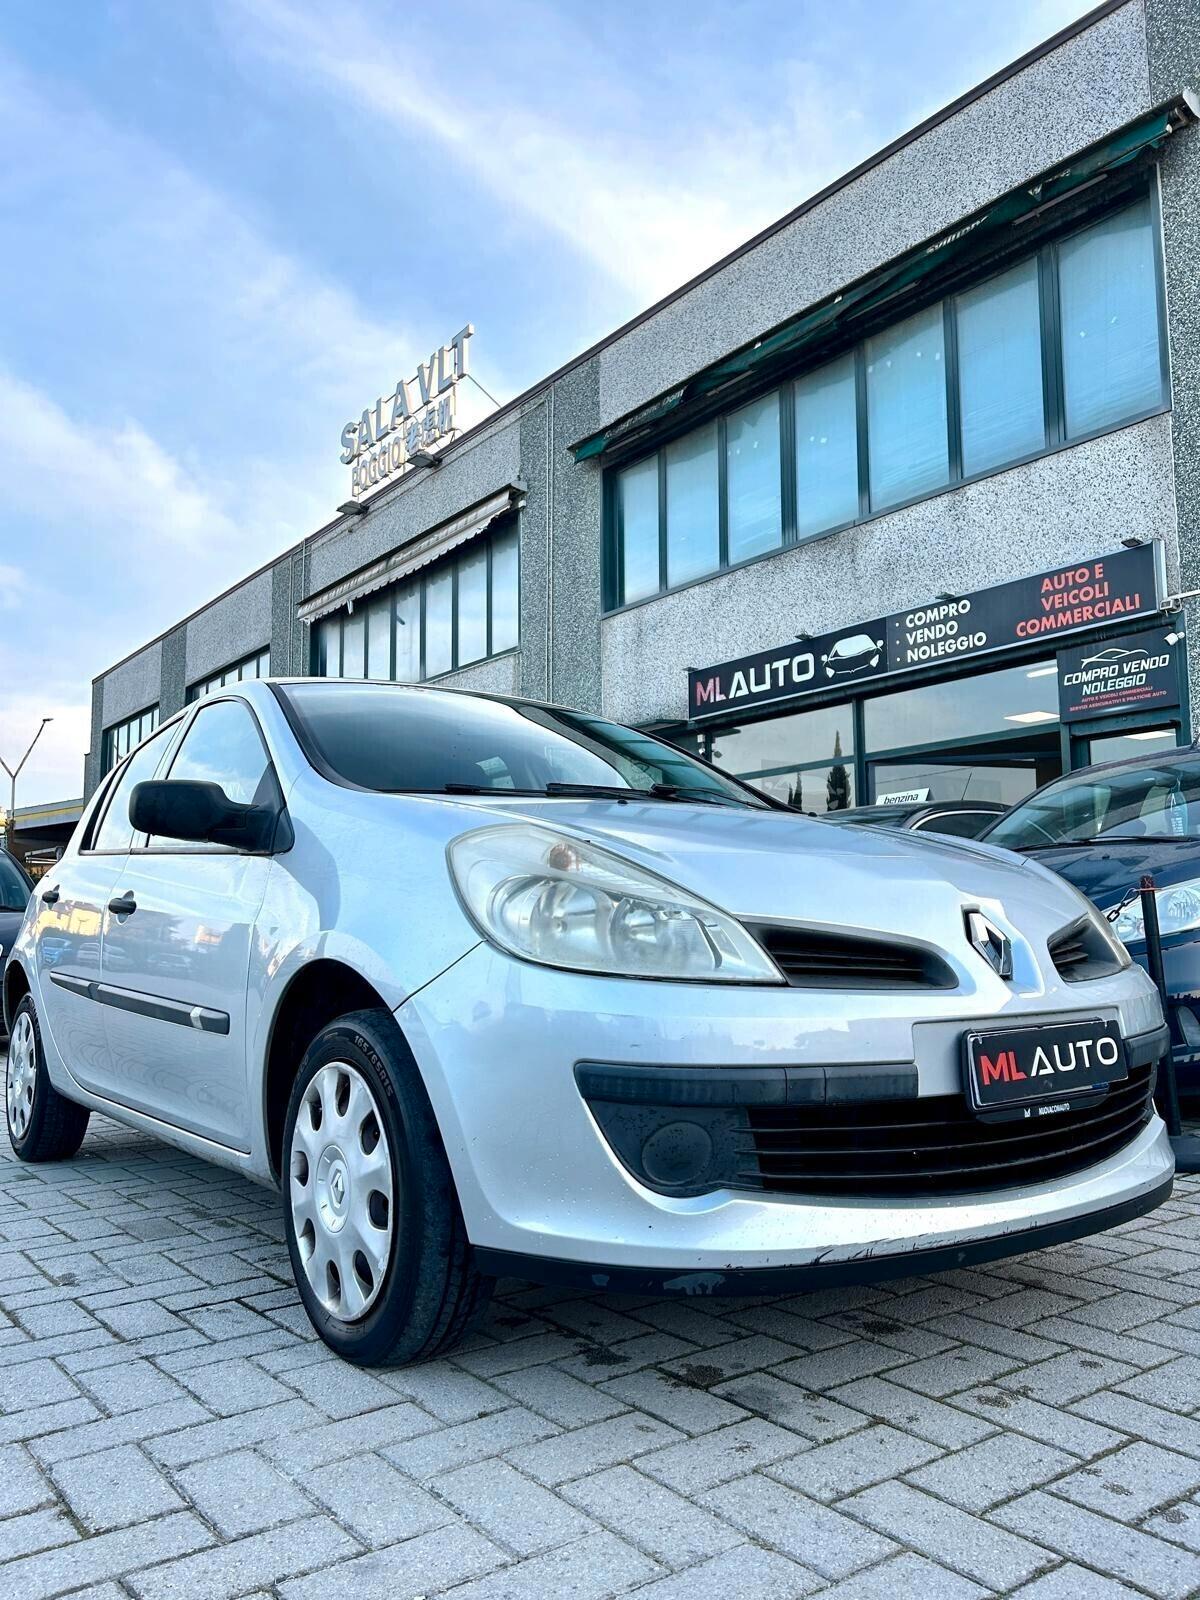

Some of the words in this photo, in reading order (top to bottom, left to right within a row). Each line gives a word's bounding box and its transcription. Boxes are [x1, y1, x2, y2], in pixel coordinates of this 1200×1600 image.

[340, 379, 414, 464] SALA
[417, 324, 475, 405] VLT
[1041, 567, 1090, 593] AUTO
[1094, 563, 1105, 579] E
[1041, 582, 1109, 611] VEICOLI
[905, 599, 971, 628] COMPRO
[1016, 594, 1141, 637] COMMERCIALI
[905, 620, 959, 646] VENDO
[906, 631, 987, 663] NOLEGGIO
[728, 652, 815, 699] AUTO
[1064, 664, 1119, 686] COMPRO
[1122, 654, 1170, 674] VENDO
[1082, 673, 1147, 695] NOLEGGIO
[884, 793, 919, 804] benzina
[980, 1051, 1028, 1085] ML
[1030, 1037, 1119, 1077] AUTO
